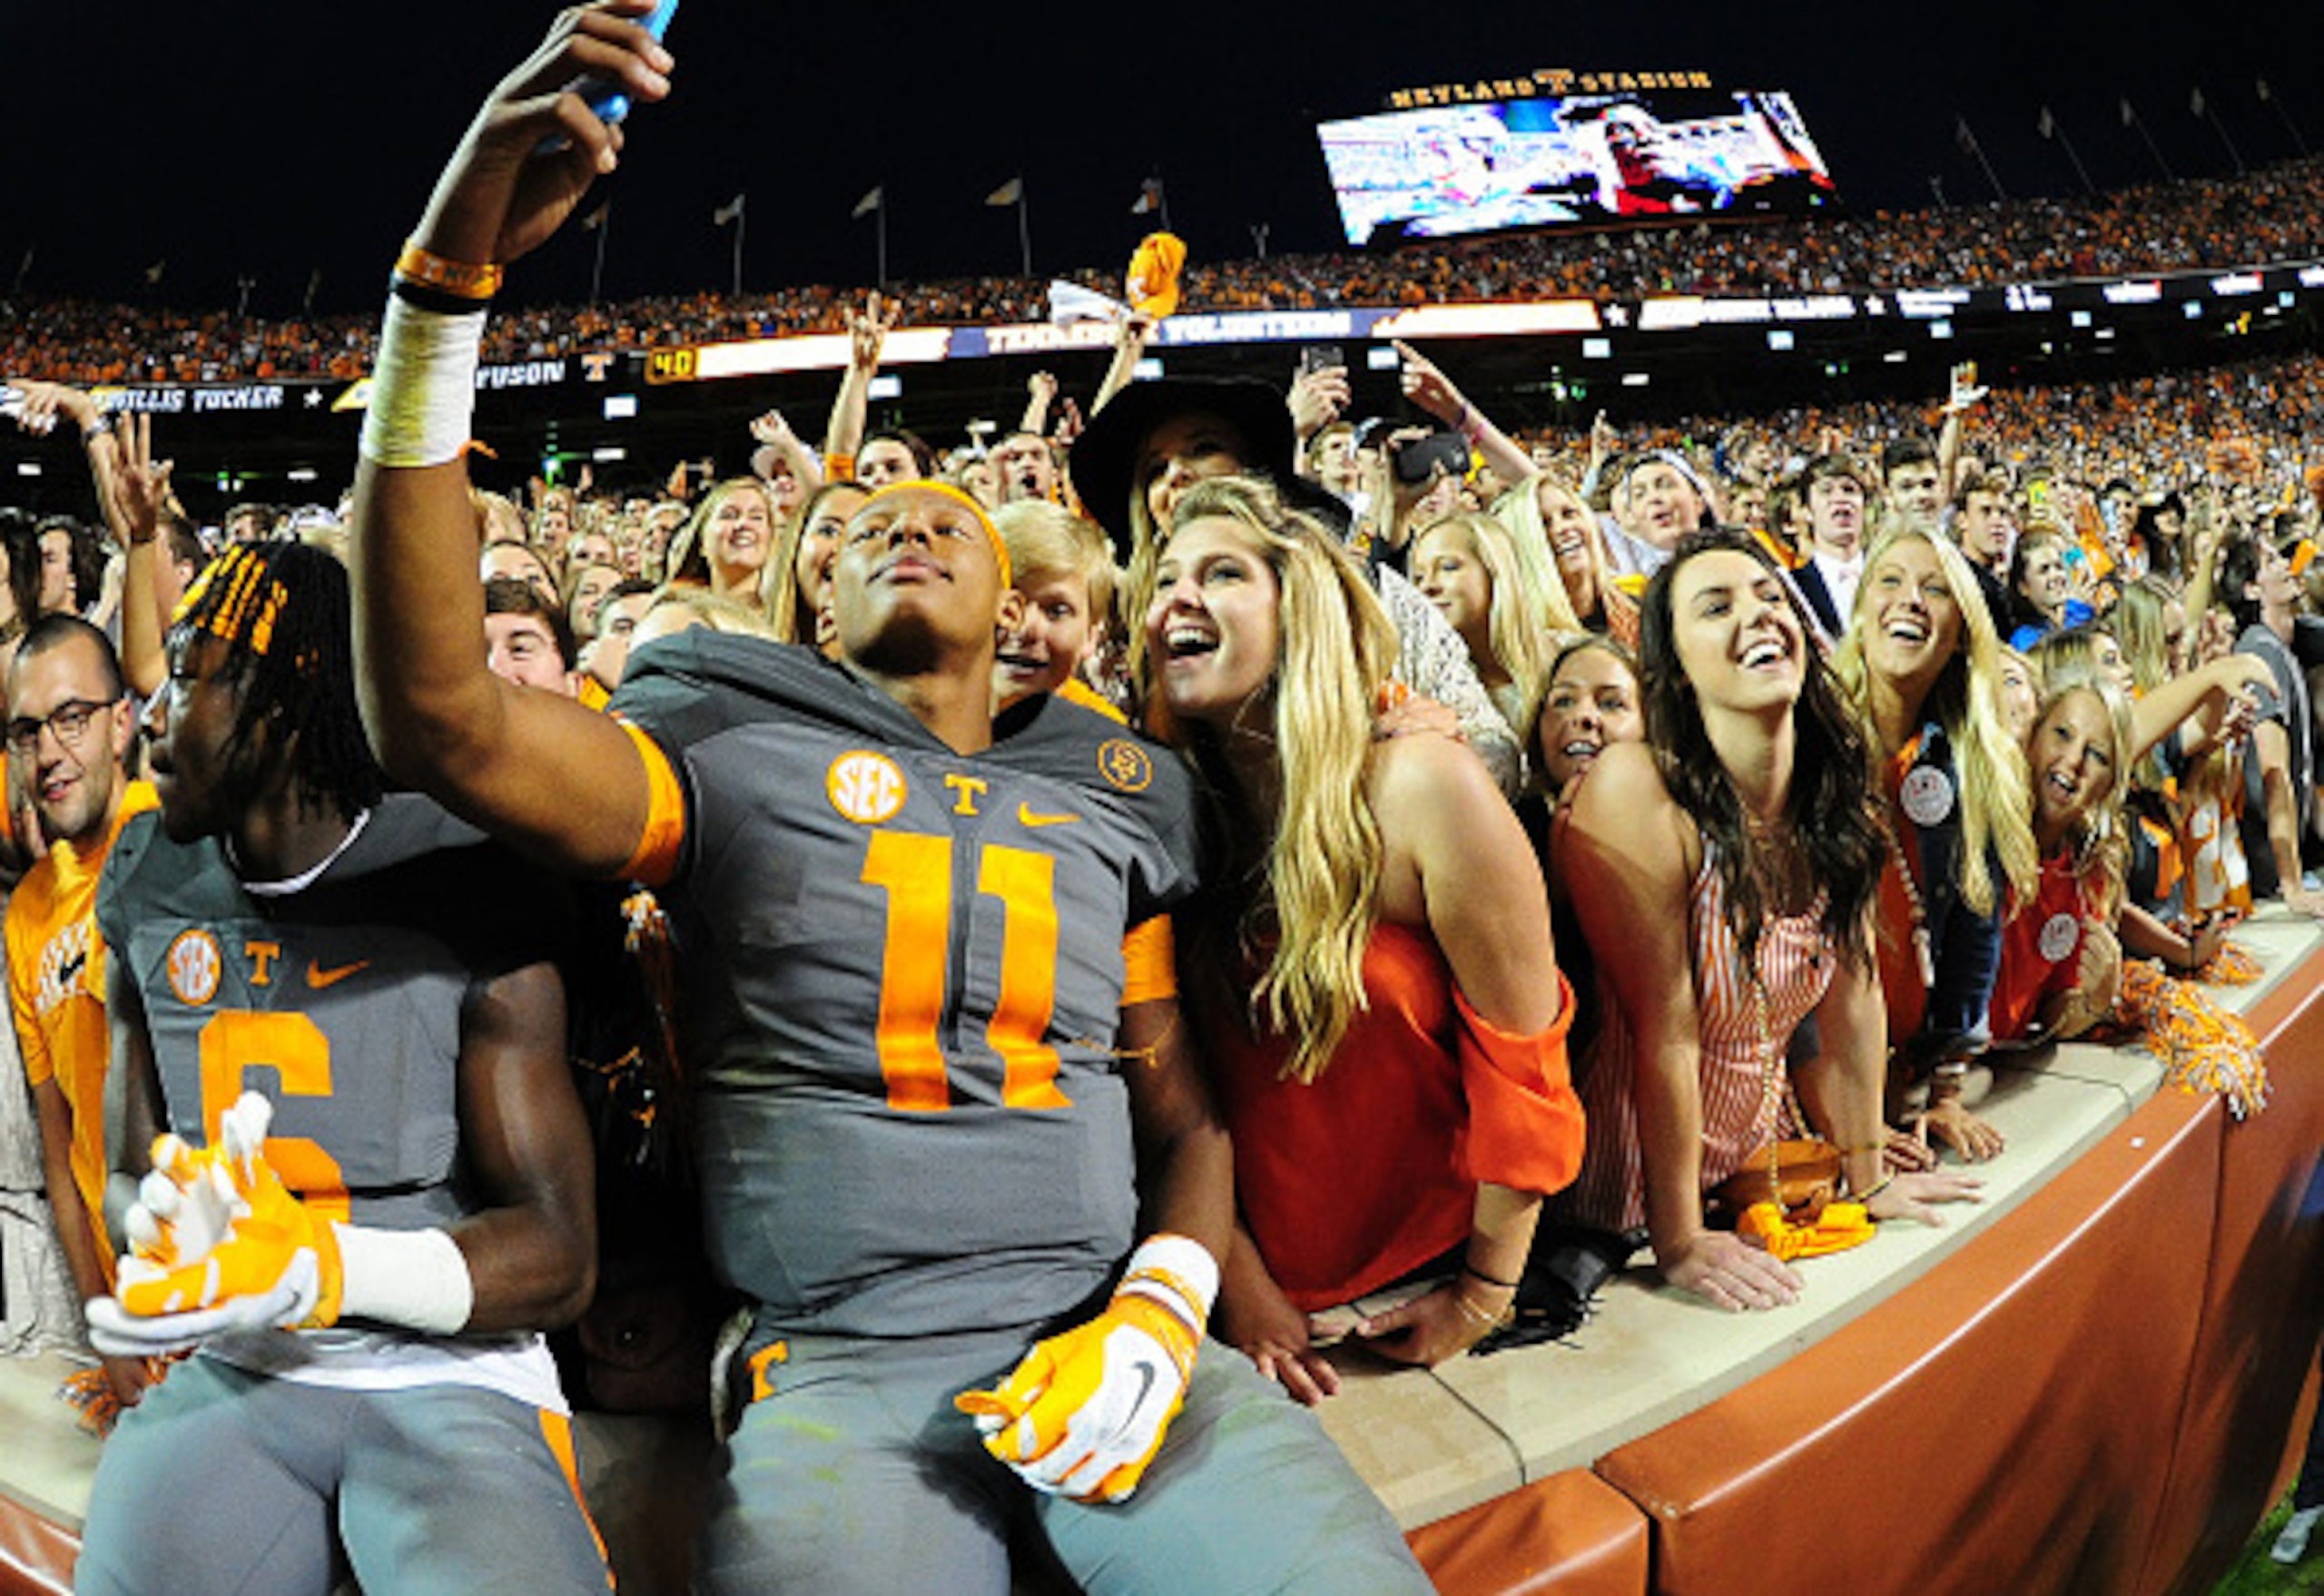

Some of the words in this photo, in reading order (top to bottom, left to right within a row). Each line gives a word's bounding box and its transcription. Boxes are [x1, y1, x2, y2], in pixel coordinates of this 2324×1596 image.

[1391, 78, 1535, 109] NEYLAND
[1578, 71, 1712, 93] STADIUM
[655, 349, 695, 378] 40
[192, 386, 284, 413] TUCKER
[834, 759, 901, 820] SEC
[944, 773, 988, 815] T
[171, 936, 219, 1001] SEC
[245, 941, 281, 985] T
[860, 828, 1074, 1111] 11
